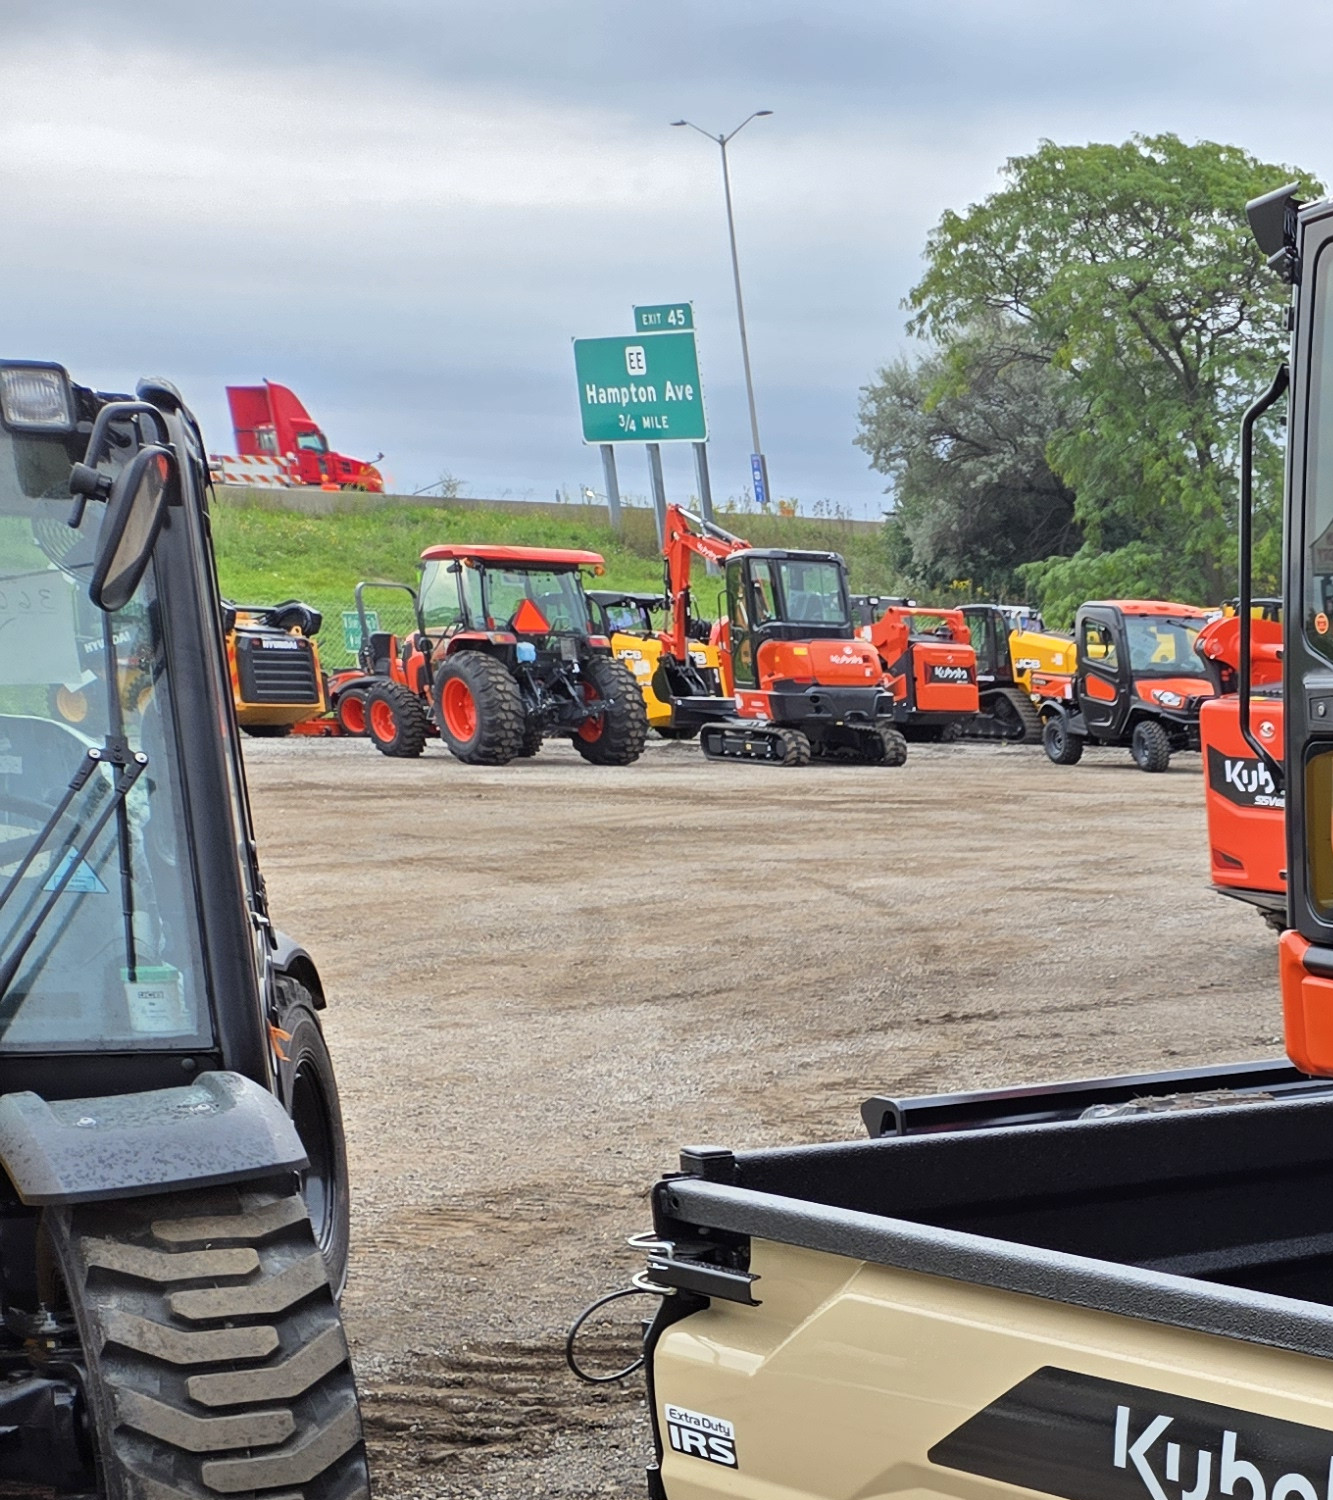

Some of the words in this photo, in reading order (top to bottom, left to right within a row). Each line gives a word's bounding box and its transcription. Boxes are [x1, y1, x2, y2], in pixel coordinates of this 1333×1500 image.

[642, 313, 661, 326] EXIT
[667, 309, 685, 326] 45
[628, 352, 644, 370] EE
[585, 383, 656, 407] Hampton
[665, 380, 694, 401] Ave
[618, 414, 637, 432] 3/4
[642, 415, 669, 429] MILE
[84, 631, 131, 653] HYUDAI
[617, 649, 642, 660] JCB
[1015, 658, 1041, 669] JCB
[1225, 760, 1275, 794] Kub
[669, 1408, 700, 1426] Extra
[702, 1417, 730, 1437] Duty
[669, 1424, 736, 1465] IRS
